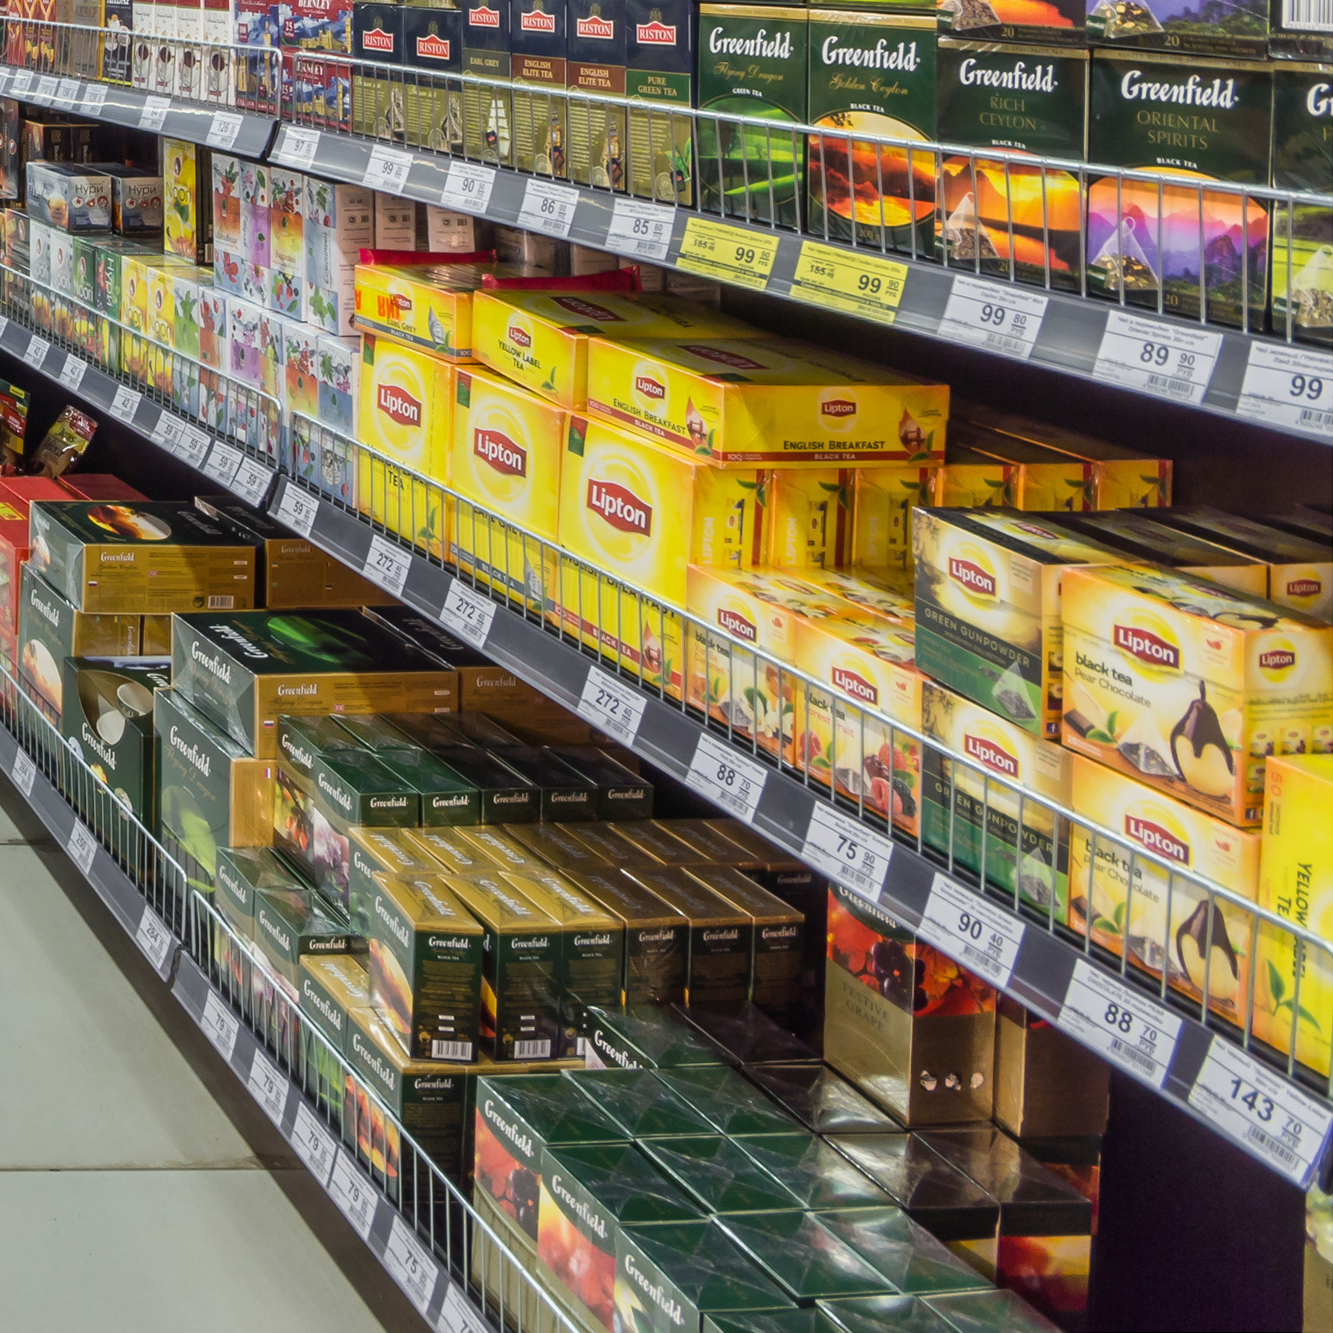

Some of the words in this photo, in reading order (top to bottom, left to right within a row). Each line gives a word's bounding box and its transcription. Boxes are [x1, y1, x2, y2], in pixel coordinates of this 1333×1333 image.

[469, 10, 499, 27] RISTON
[578, 19, 613, 37] RISTON
[638, 27, 673, 42] RISTON
[708, 27, 794, 59] Greenfield
[1164, 34, 1180, 48] 20
[821, 36, 920, 71] Greenfield
[578, 77, 597, 86] ELITE
[599, 78, 612, 87] TEA
[580, 68, 609, 79] ENGLISH
[959, 58, 1058, 92] Greenfield
[1121, 71, 1239, 108] Greenfield
[382, 162, 394, 176] 99
[74, 184, 105, 196] Нури
[462, 177, 475, 192] 90
[541, 198, 556, 213] 86
[633, 218, 649, 235] 85
[858, 273, 882, 294] 99
[980, 304, 1005, 327] 99
[1013, 313, 1027, 326] 80
[1139, 342, 1169, 366] 89
[1179, 353, 1196, 366] 90
[1289, 374, 1324, 401] 99
[378, 383, 422, 429] Lipton
[822, 400, 856, 418] Lipton
[474, 429, 526, 476] Lipton
[783, 439, 825, 450] ENGLISH
[829, 439, 886, 452] BREAKFAST
[814, 452, 836, 460] BLACK
[246, 472, 258, 486] 59
[589, 482, 650, 533] Lipton
[101, 552, 134, 562] Greenfield
[374, 553, 394, 571] 272
[951, 560, 994, 595] Lipton
[456, 598, 477, 620] 272
[924, 608, 965, 638] GREEN
[966, 624, 1031, 668] GUNPOWDER
[1117, 628, 1179, 666] Lipton
[191, 642, 231, 686] Greenfield
[1075, 651, 1112, 680] black
[1111, 669, 1133, 687] tea
[277, 683, 318, 696] Greenfield
[833, 670, 877, 704] Lipton
[1075, 670, 1097, 686] Pear
[1097, 677, 1152, 708] Chocolate
[594, 690, 621, 717] 272
[170, 724, 211, 778] Greenfield
[716, 763, 737, 787] 88
[739, 777, 753, 792] 70
[369, 796, 408, 808] Greenfield
[836, 834, 859, 862] 75
[862, 851, 876, 866] 90
[429, 935, 470, 948] Greenfield
[958, 913, 984, 942] 90
[990, 933, 1004, 948] 40
[1103, 1002, 1134, 1033] 88
[1141, 1025, 1159, 1041] 70
[352, 1033, 396, 1091] Greenfield
[1229, 1077, 1276, 1123] 143
[1285, 1118, 1304, 1136] 70
[484, 1099, 533, 1158] Greenfield
[307, 1133, 321, 1154] 79
[551, 1174, 608, 1241] Greenfield
[405, 1250, 420, 1272] 75
[625, 1256, 685, 1326] Greenfield
